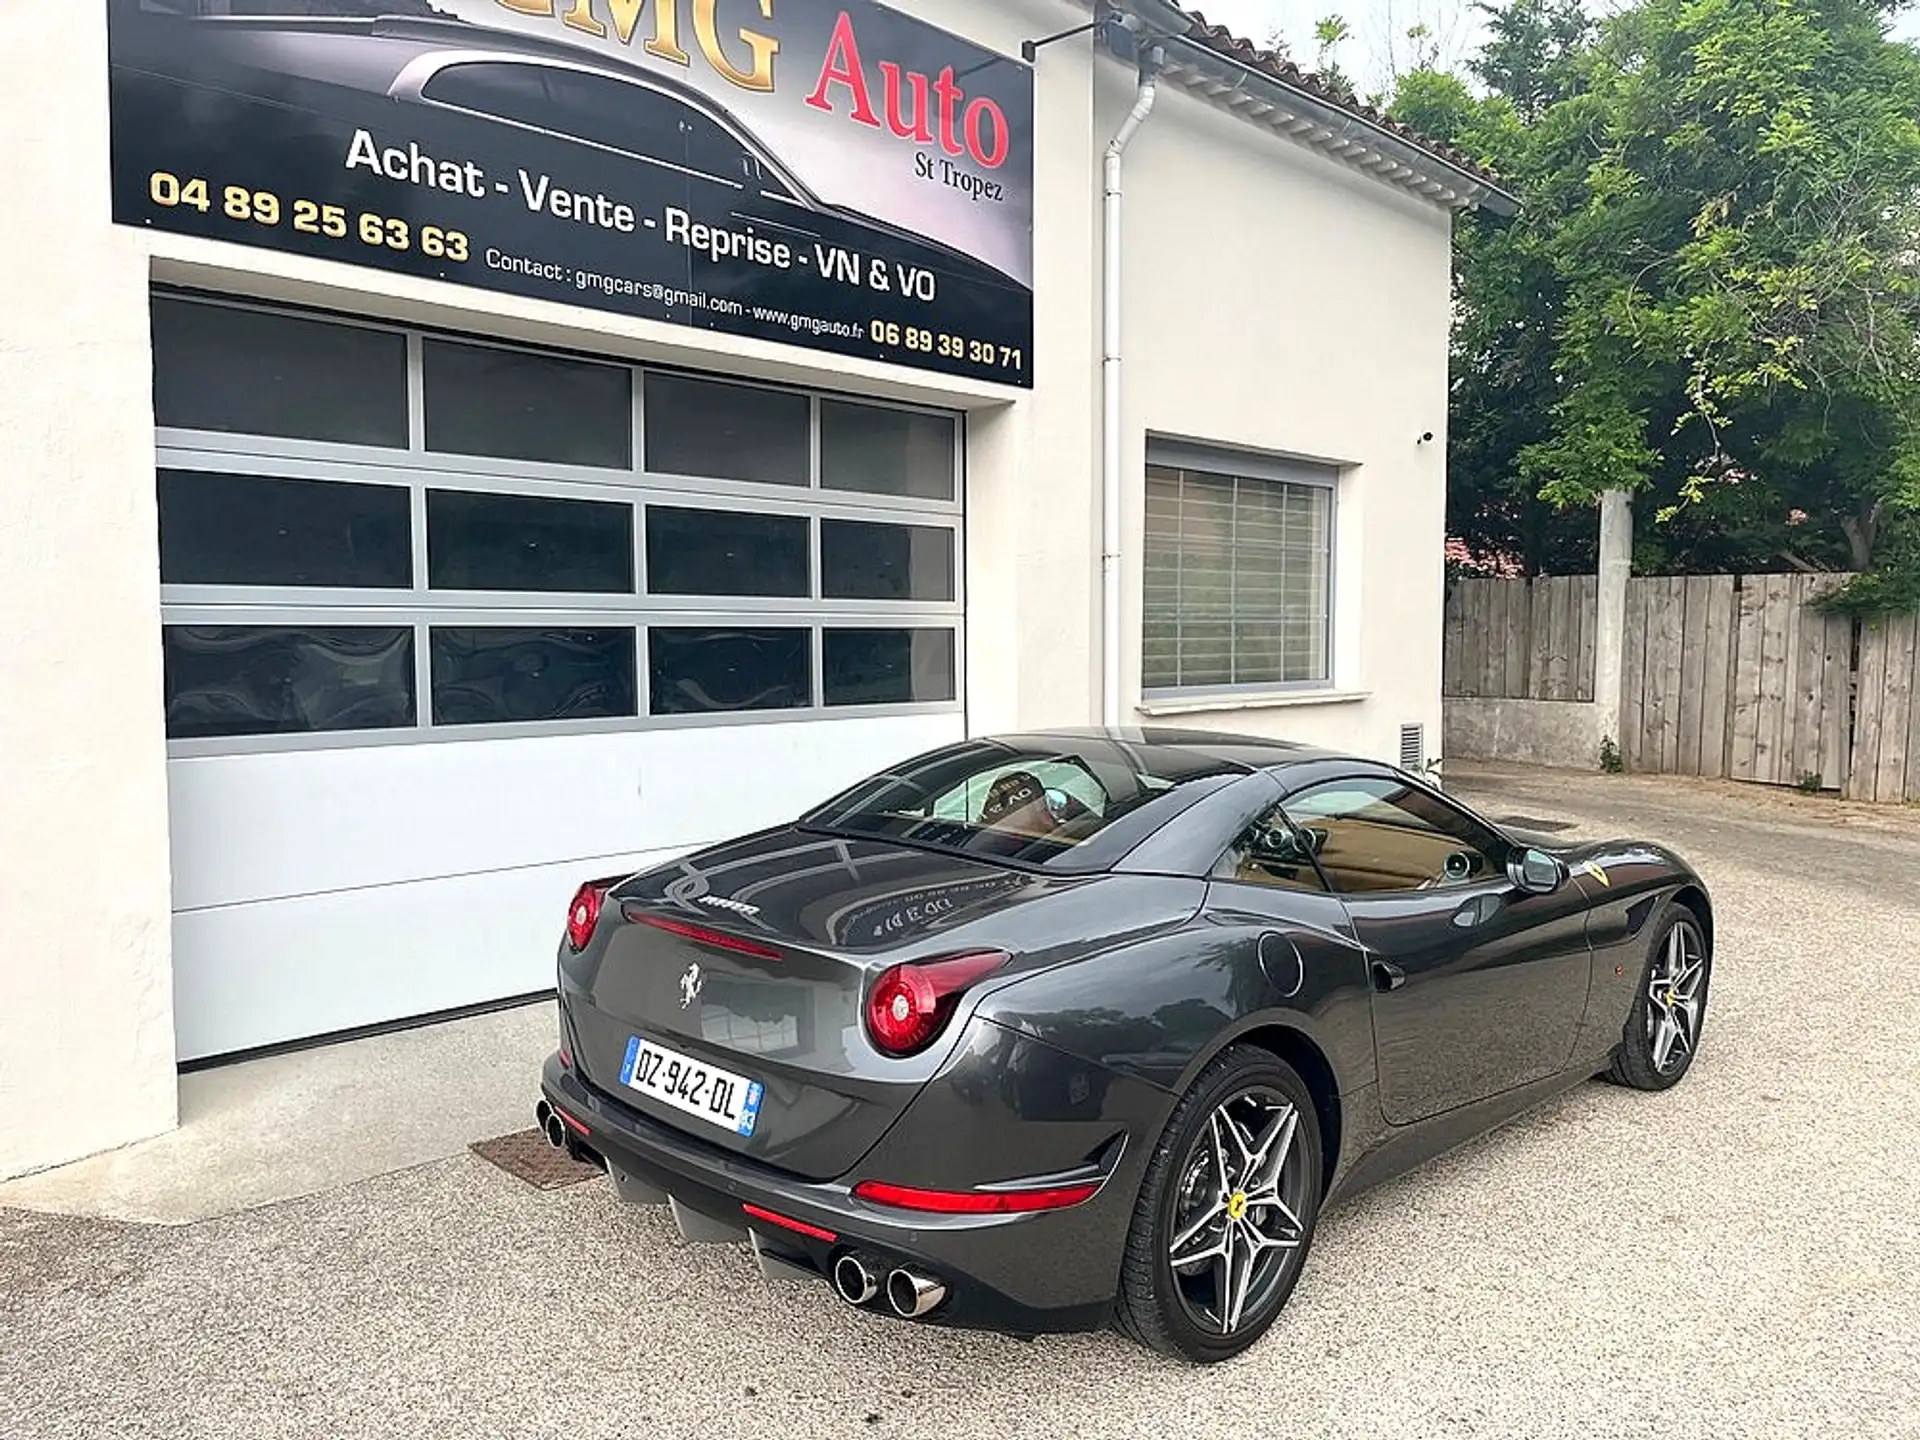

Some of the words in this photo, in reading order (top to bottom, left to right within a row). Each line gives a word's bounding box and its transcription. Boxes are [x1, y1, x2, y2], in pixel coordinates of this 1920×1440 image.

[805, 11, 1009, 168] Auto
[914, 152, 935, 180] St
[939, 161, 1003, 203] Tropez
[149, 172, 210, 212] 04
[223, 185, 280, 225] 89
[293, 199, 347, 238] 25
[359, 213, 410, 251] 63
[420, 226, 470, 262] 63
[345, 128, 485, 198] Achat
[518, 169, 635, 234] Vente
[665, 207, 791, 270] Reprise
[815, 244, 861, 286] VN
[868, 259, 890, 291] &
[897, 263, 936, 301] VO
[575, 269, 743, 315] gmgcars@gmail.com
[752, 308, 864, 340] www.gmgauto.fr
[871, 320, 900, 345] 06
[905, 327, 932, 353] 89
[937, 334, 964, 359] 39
[970, 340, 995, 365] 30
[1000, 347, 1022, 370] 71
[636, 1049, 736, 1120] DZ-942-DL
